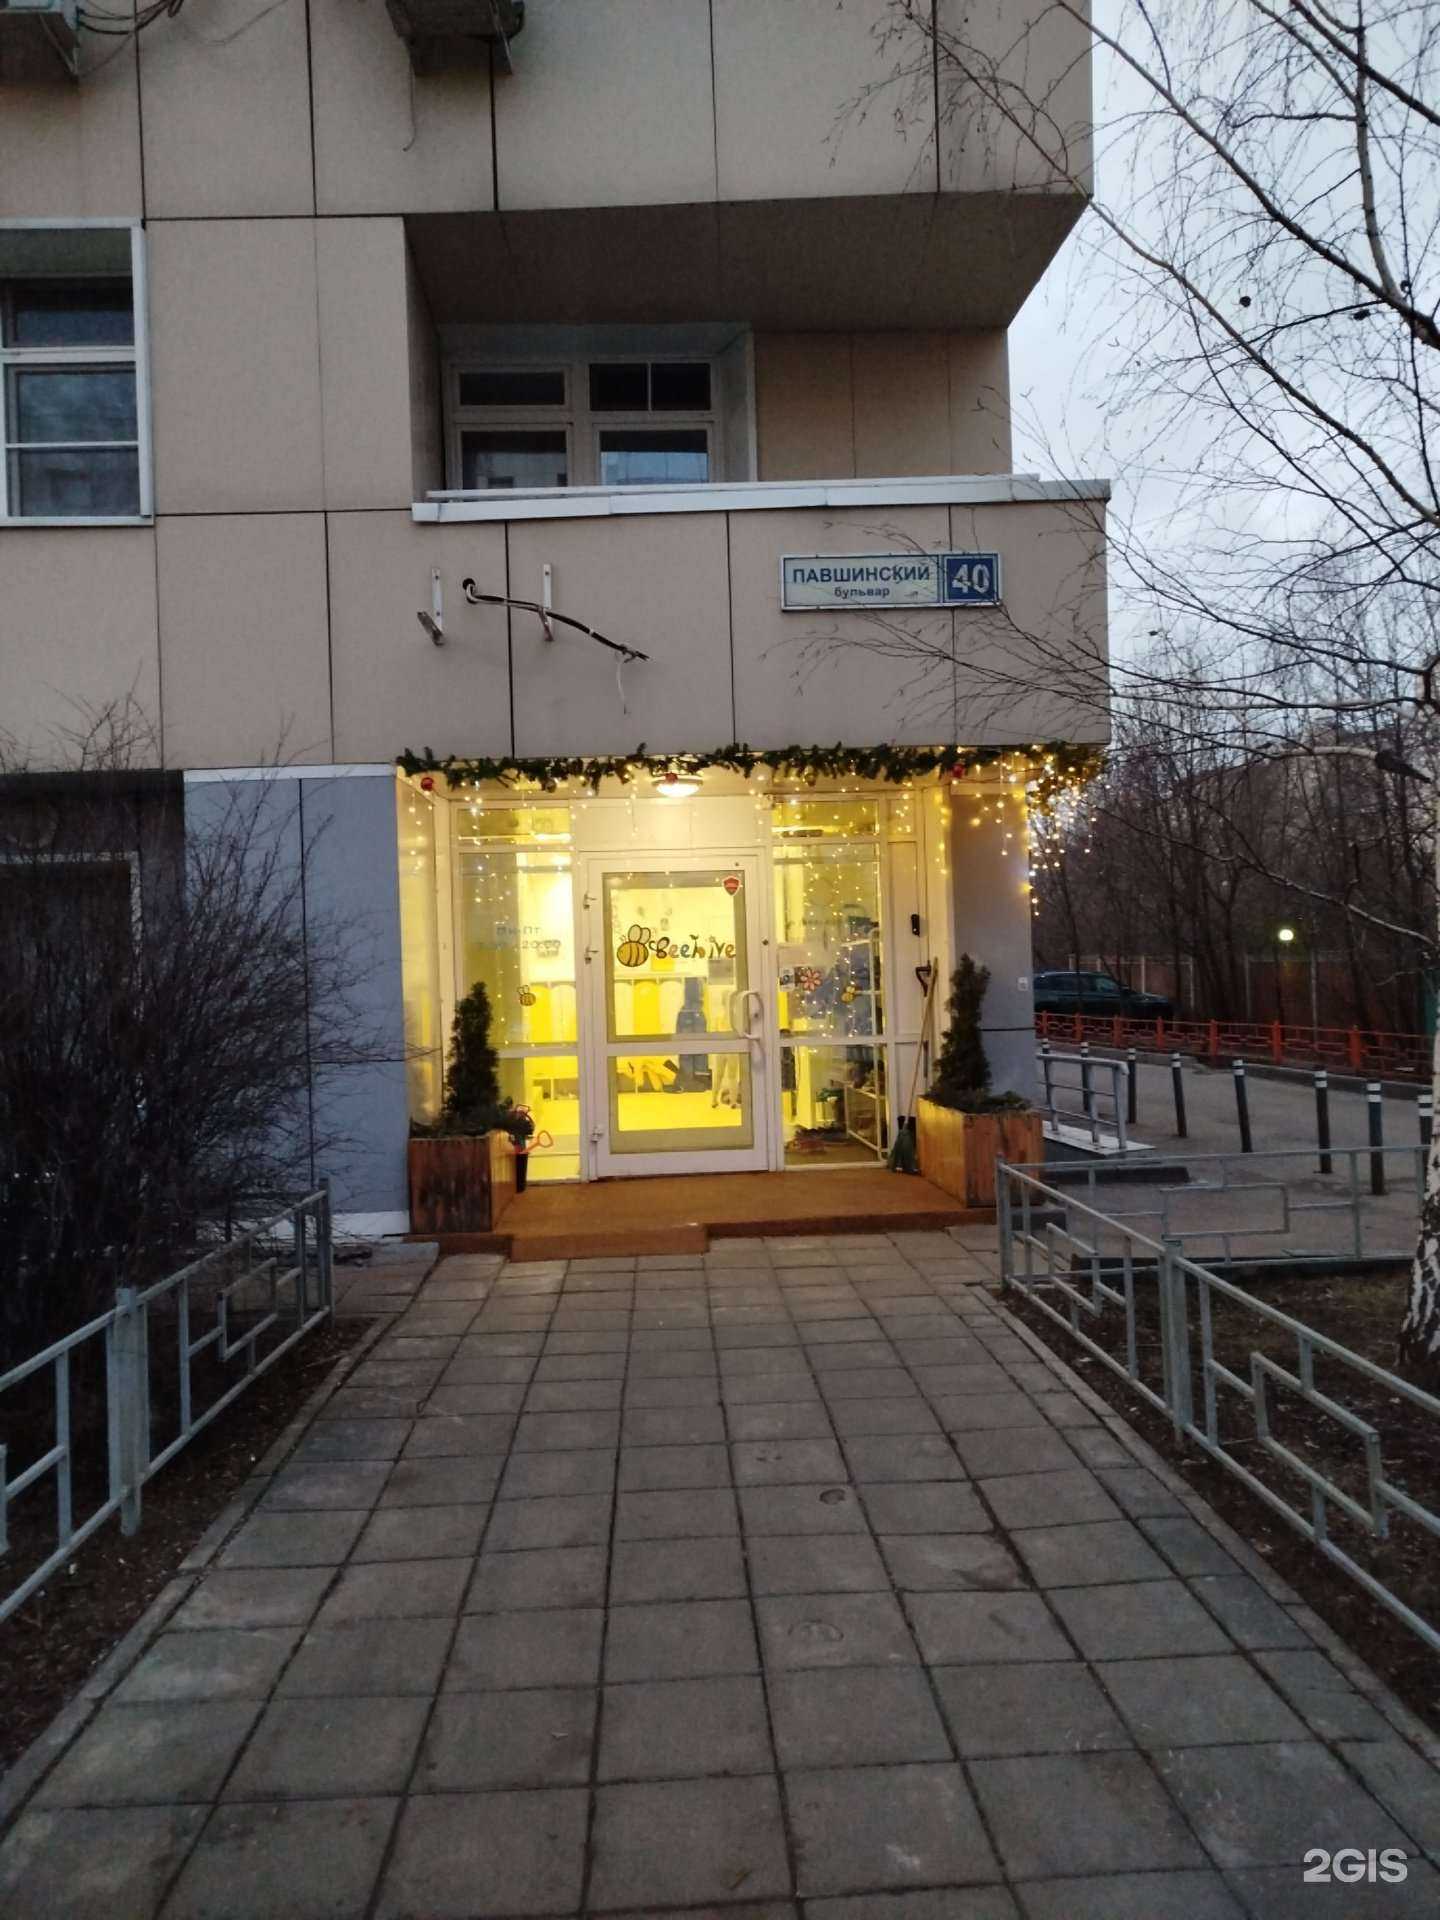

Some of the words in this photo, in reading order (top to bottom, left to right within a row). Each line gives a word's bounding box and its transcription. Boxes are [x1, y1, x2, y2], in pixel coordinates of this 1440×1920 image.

[951, 563, 990, 593] 40
[834, 586, 890, 600] бульвар
[649, 935, 737, 959] Beehive
